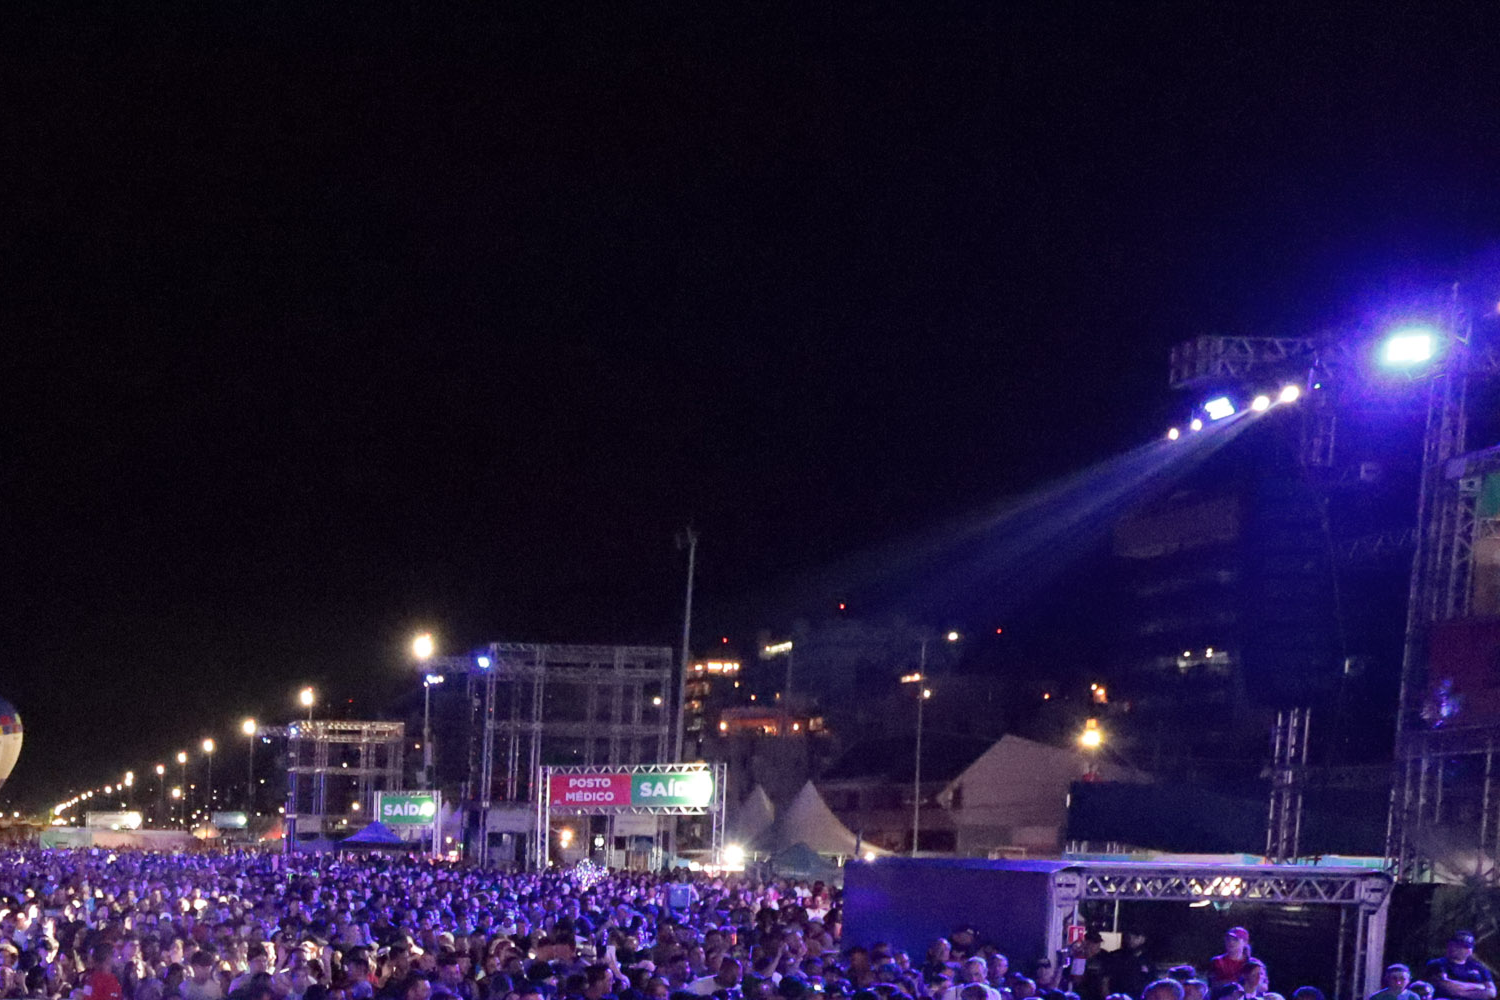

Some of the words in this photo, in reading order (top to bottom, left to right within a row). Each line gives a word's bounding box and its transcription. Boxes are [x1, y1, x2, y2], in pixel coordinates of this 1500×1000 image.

[569, 778, 611, 788] POSTO
[639, 778, 705, 797] SAÍD
[565, 790, 615, 802] MÉDICO
